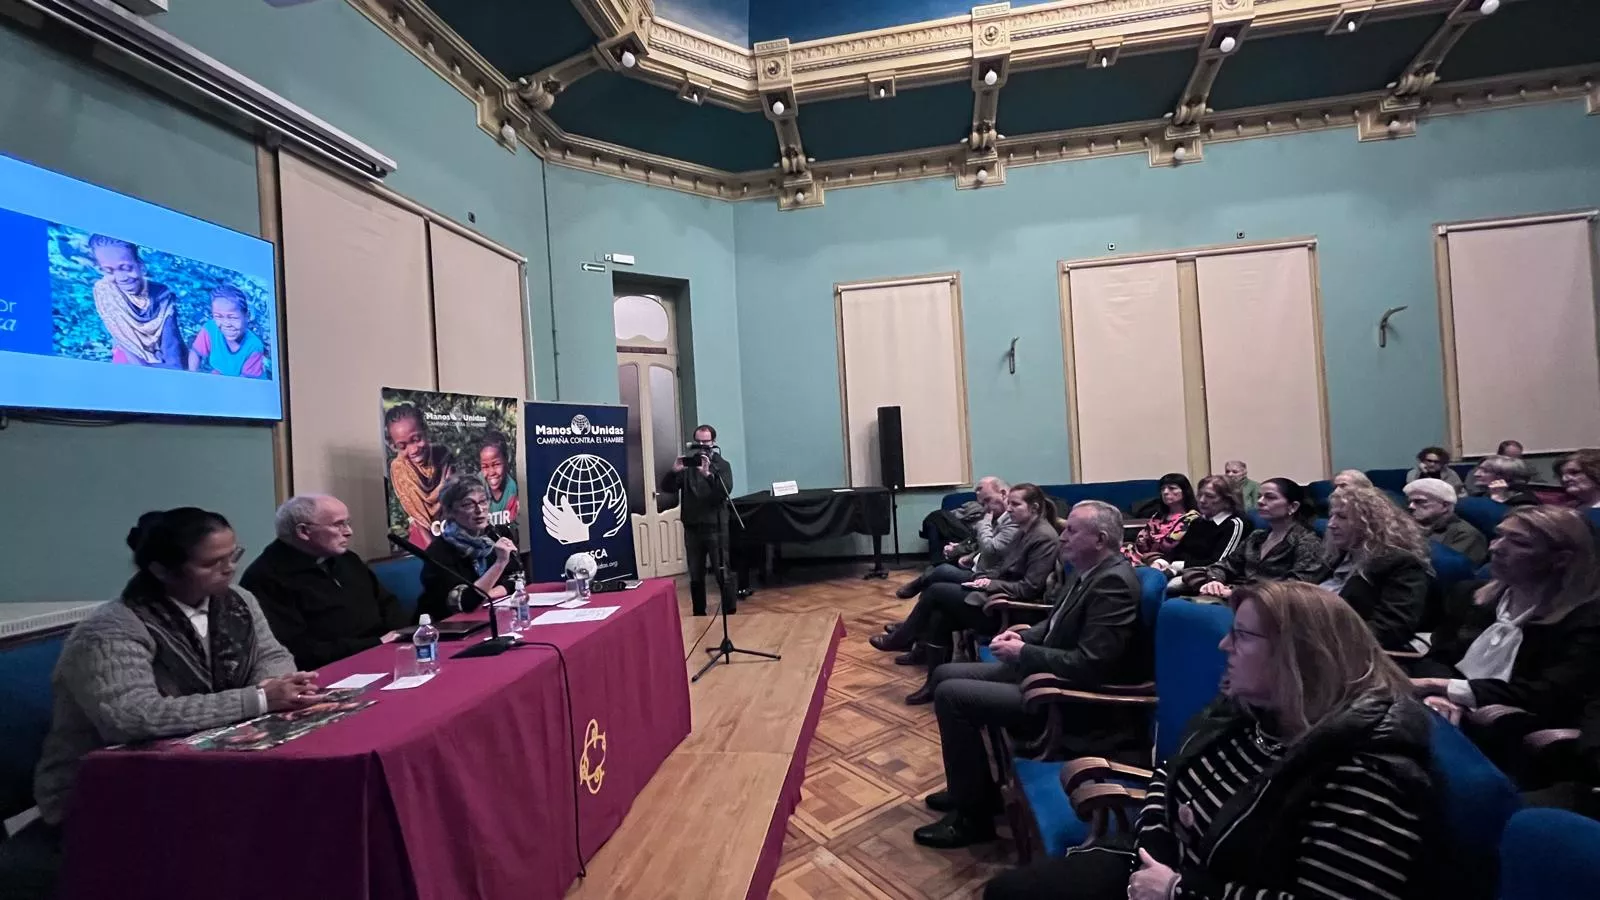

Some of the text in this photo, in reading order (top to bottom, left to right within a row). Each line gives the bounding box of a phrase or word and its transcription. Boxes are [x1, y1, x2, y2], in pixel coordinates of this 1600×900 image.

[425, 412, 487, 422] Manos Unidas
[535, 424, 624, 436] Manos Unidas
[536, 435, 569, 445] CAMPAÑA
[569, 436, 596, 444] CONTRA
[596, 436, 603, 444] EL
